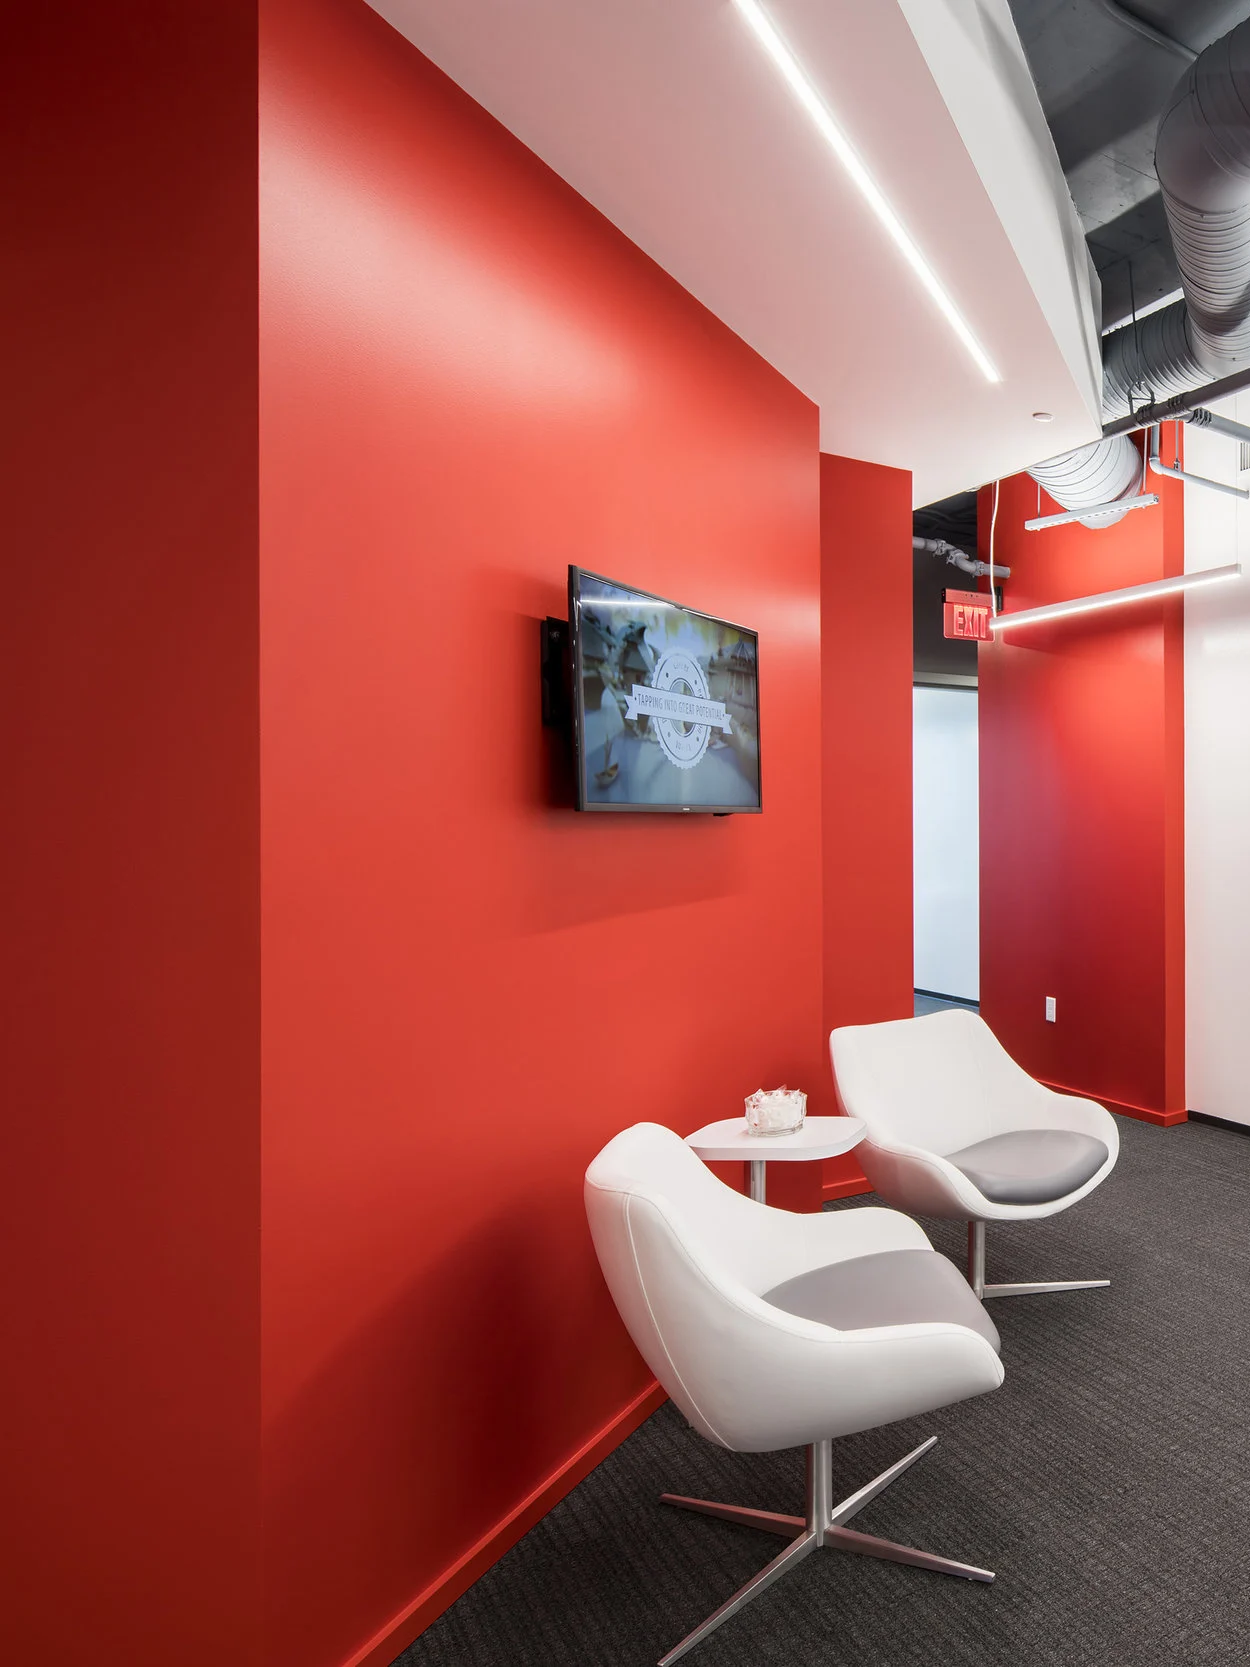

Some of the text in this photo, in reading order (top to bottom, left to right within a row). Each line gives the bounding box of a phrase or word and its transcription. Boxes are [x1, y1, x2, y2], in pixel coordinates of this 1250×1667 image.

[953, 604, 988, 638] EXIT
[637, 693, 723, 721] TAPPING INTO GREAT POTENTIAL
